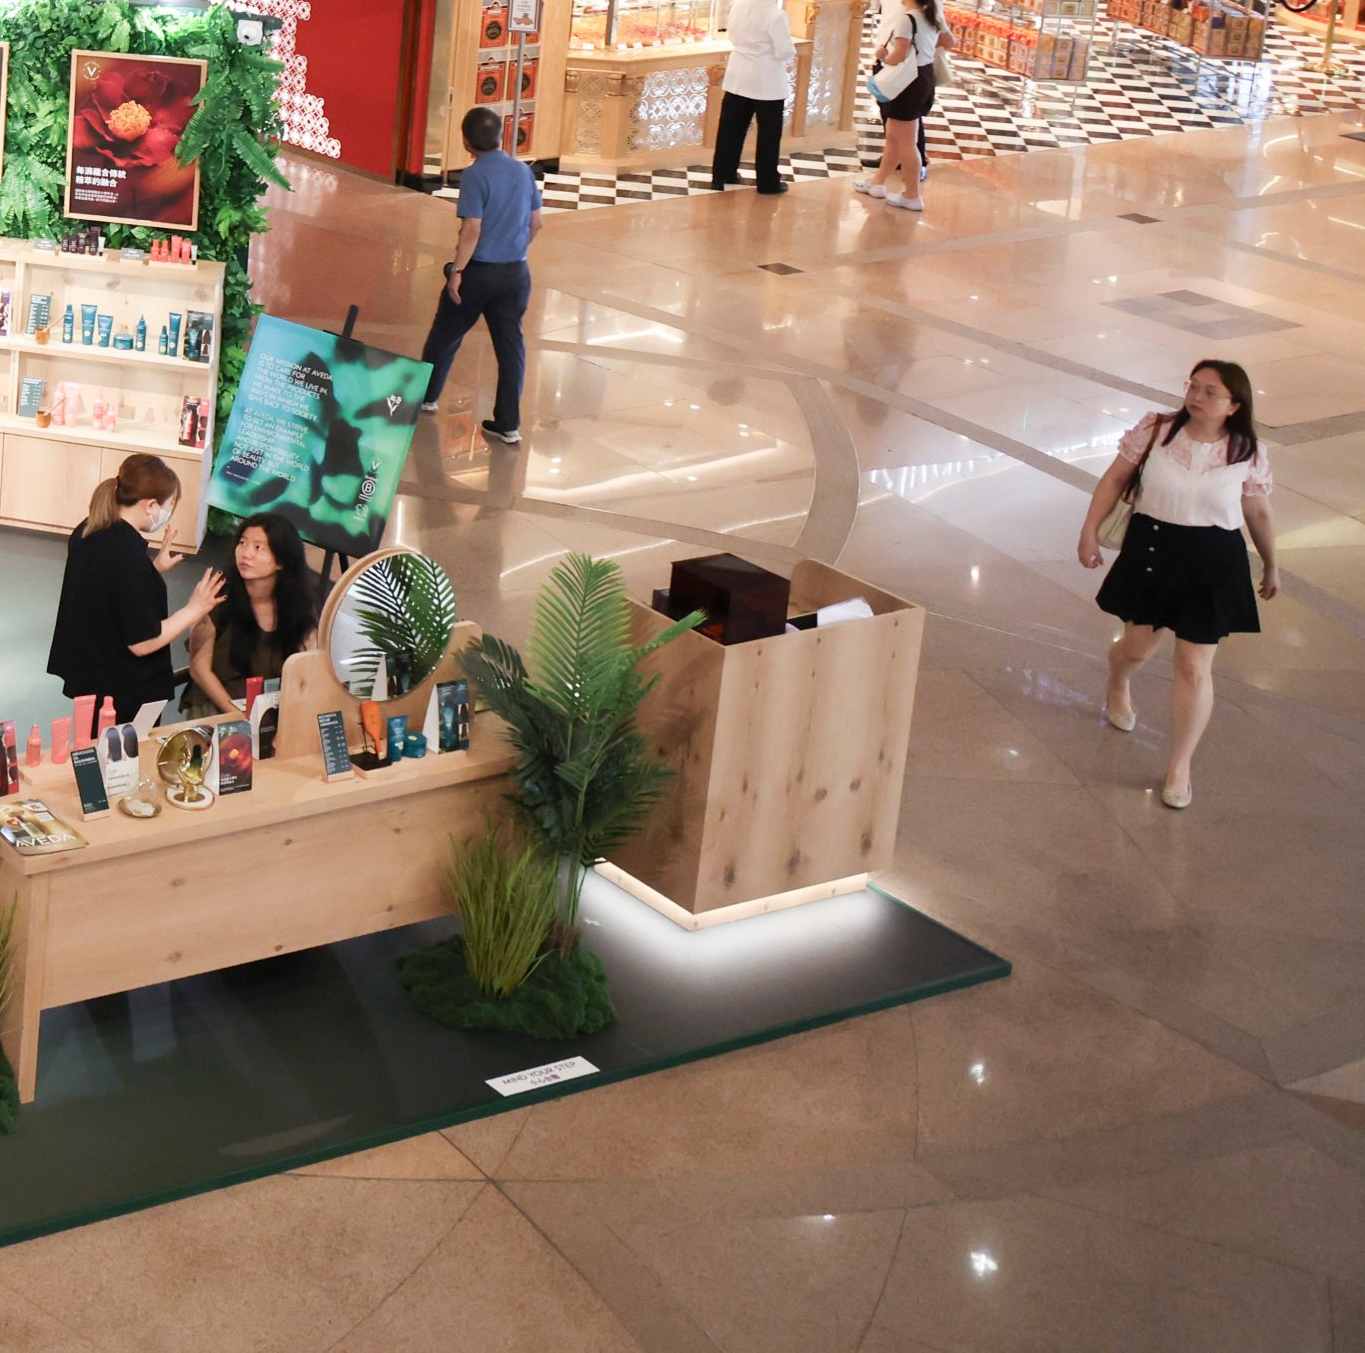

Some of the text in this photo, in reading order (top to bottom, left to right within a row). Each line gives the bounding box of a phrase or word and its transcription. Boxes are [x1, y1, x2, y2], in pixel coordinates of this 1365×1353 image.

[292, 371, 306, 380] FOR
[16, 833, 77, 847] AVEDA
[502, 1061, 576, 1086] MIND YOUR STEP
